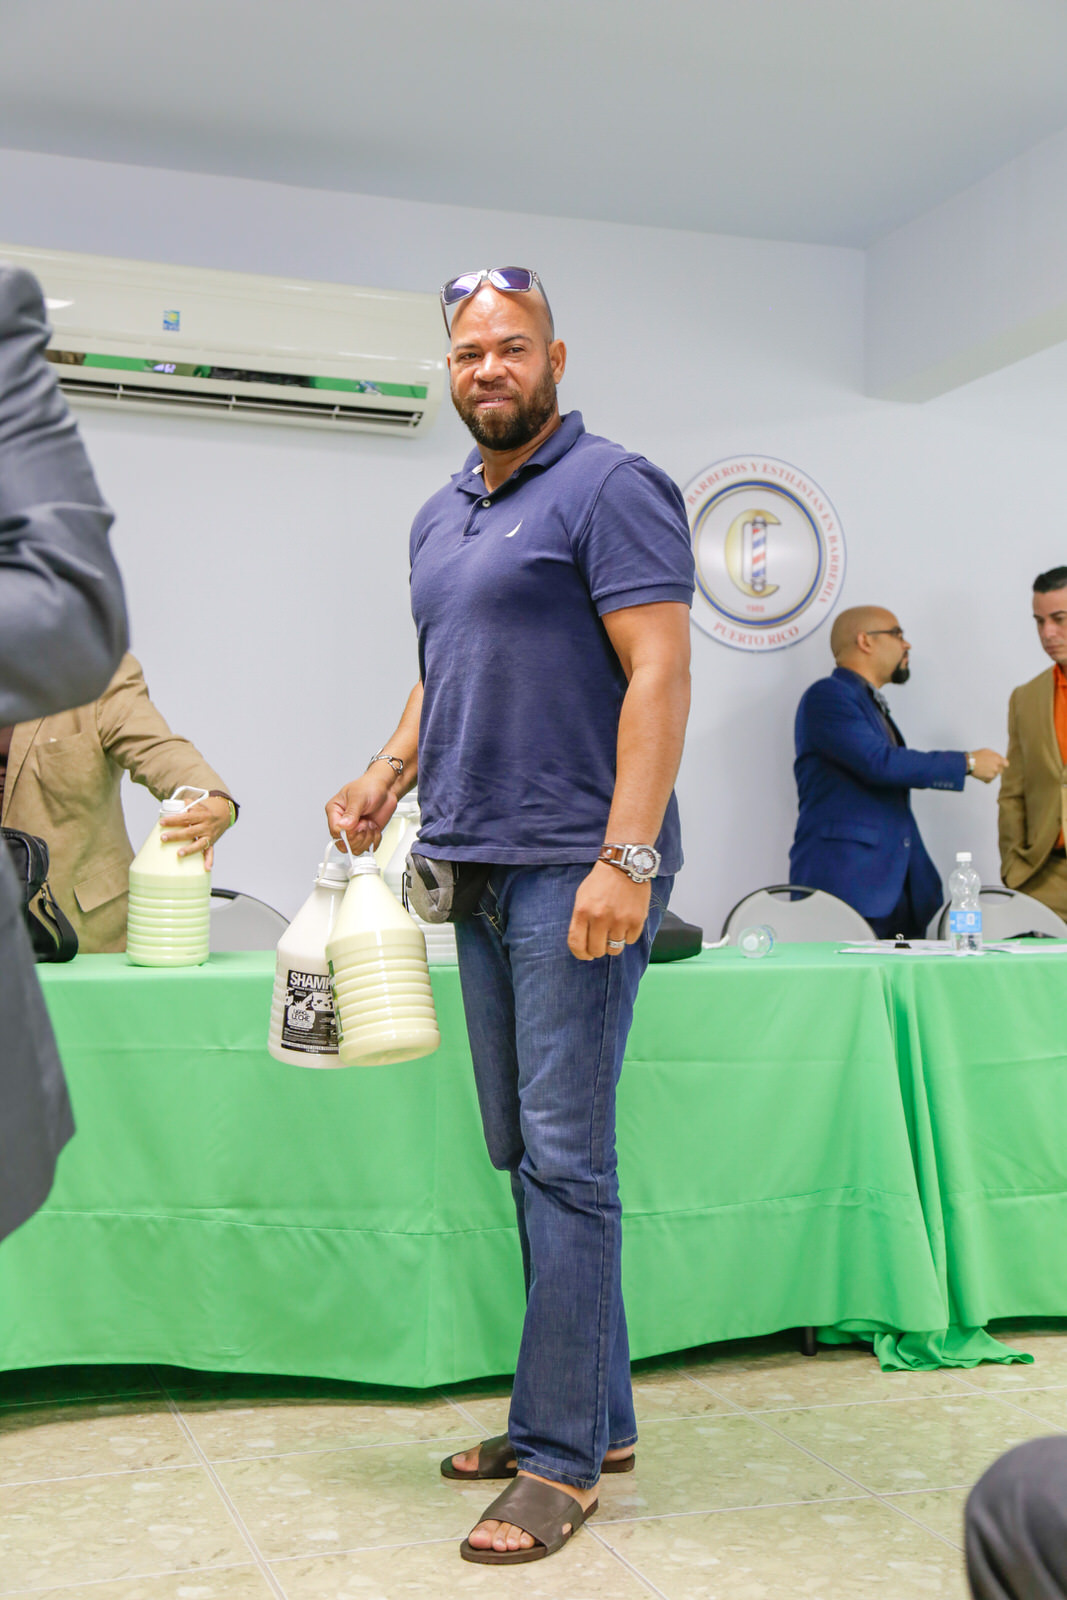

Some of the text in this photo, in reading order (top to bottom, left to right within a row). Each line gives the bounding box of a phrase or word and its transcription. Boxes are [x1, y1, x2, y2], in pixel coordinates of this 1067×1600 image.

[687, 462, 840, 604] BARBEROS Y ESTILISTAS EN BARBERIA
[713, 622, 800, 646] PUERTO RICO
